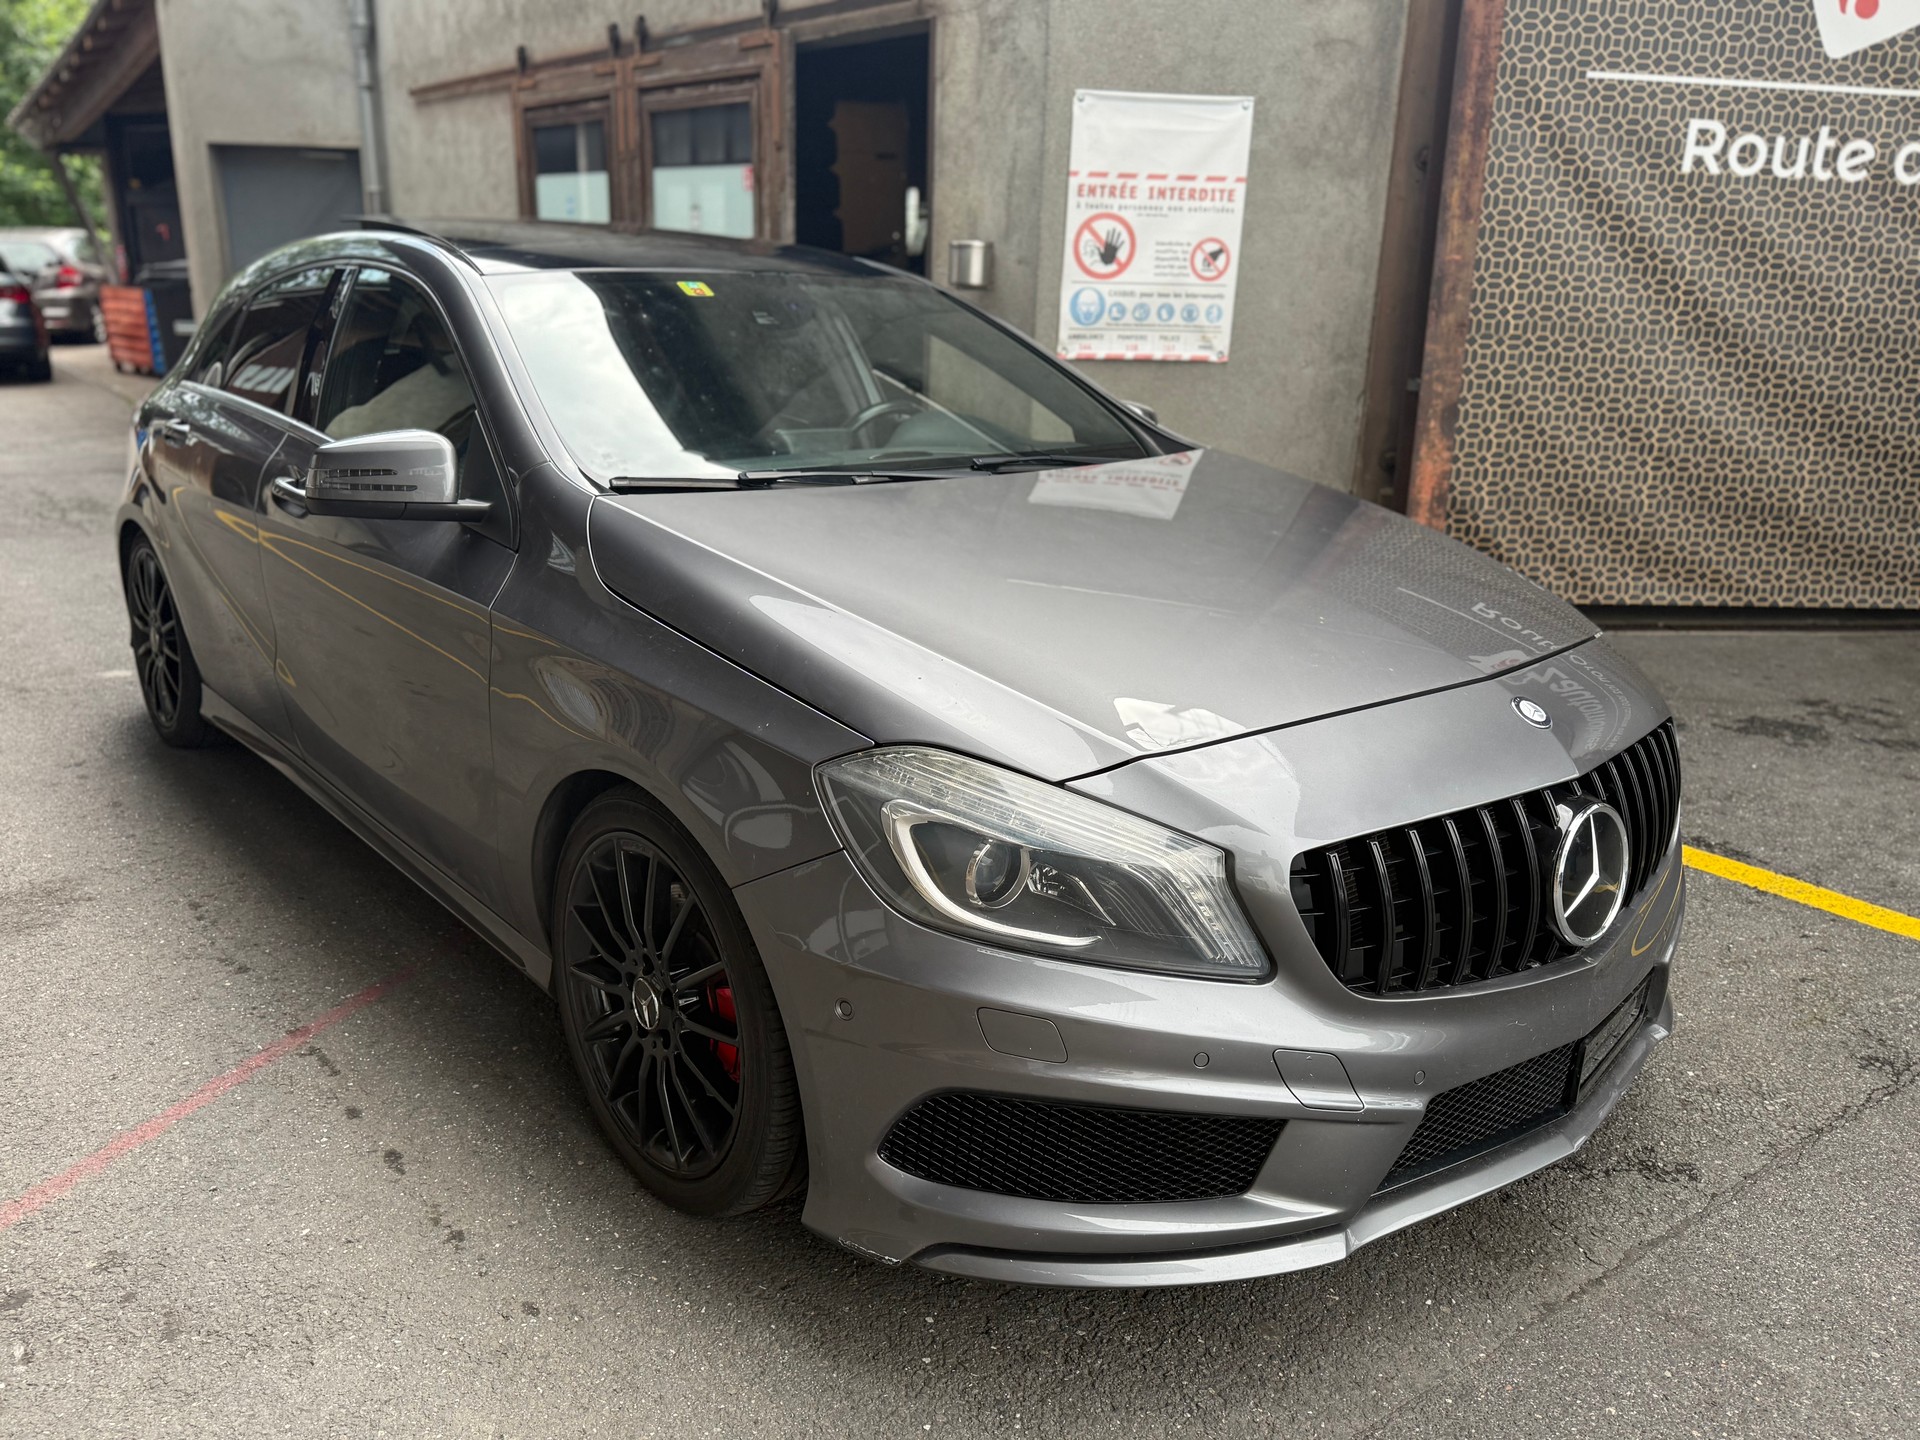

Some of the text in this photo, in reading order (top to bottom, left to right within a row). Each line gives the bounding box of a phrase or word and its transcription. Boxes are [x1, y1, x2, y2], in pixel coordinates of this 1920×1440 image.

[1681, 118, 1875, 182] Route
[1077, 181, 1236, 203] ENTRÉE INTERDITE
